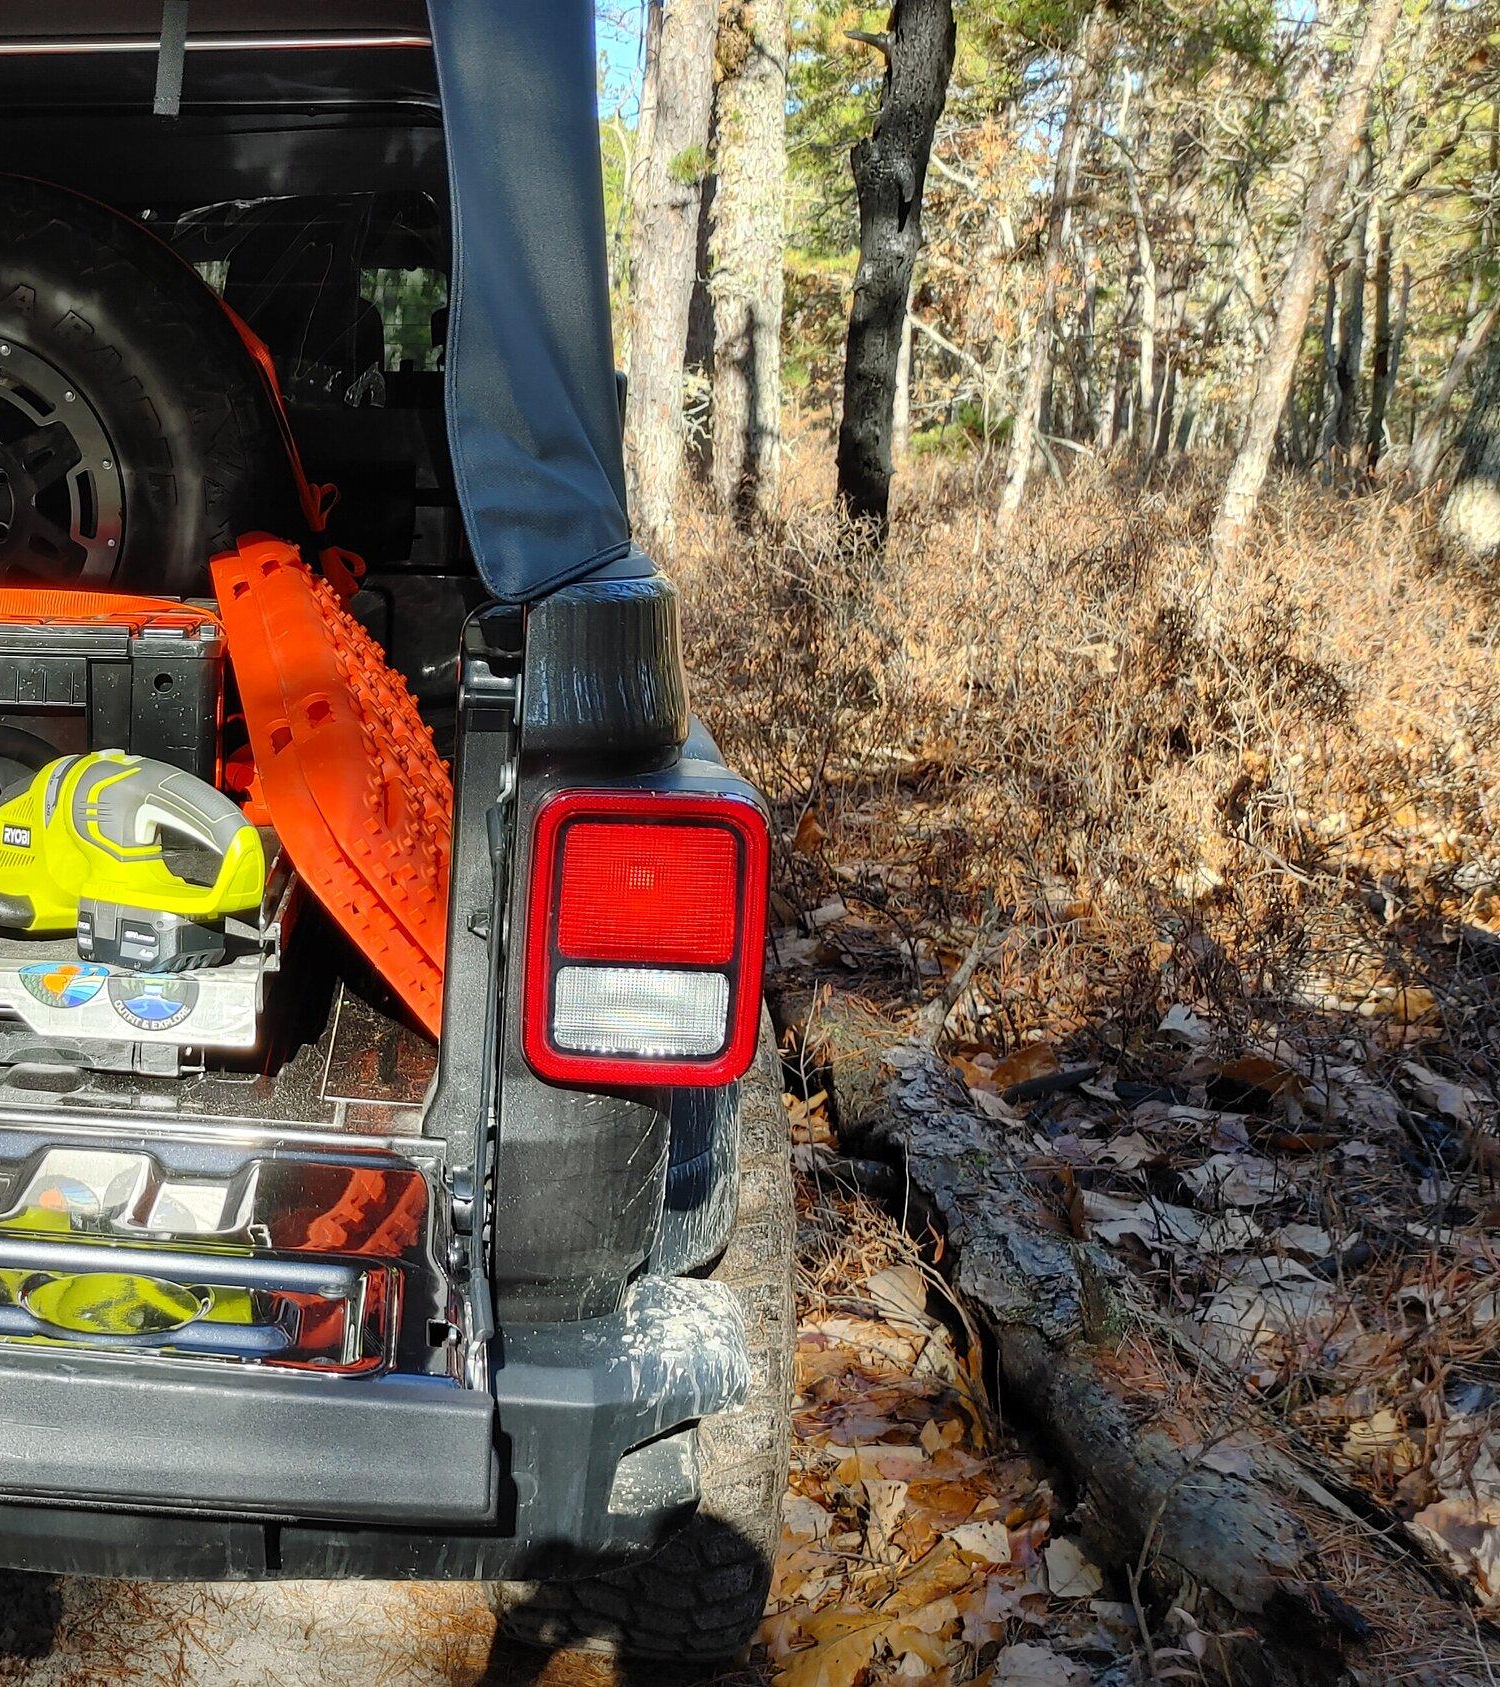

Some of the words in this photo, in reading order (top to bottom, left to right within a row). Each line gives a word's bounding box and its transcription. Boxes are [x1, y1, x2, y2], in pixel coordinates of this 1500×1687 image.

[4, 827, 30, 846] RYOBI
[114, 999, 141, 1026] OUTFIT
[151, 1004, 192, 1030] EXPLORE
